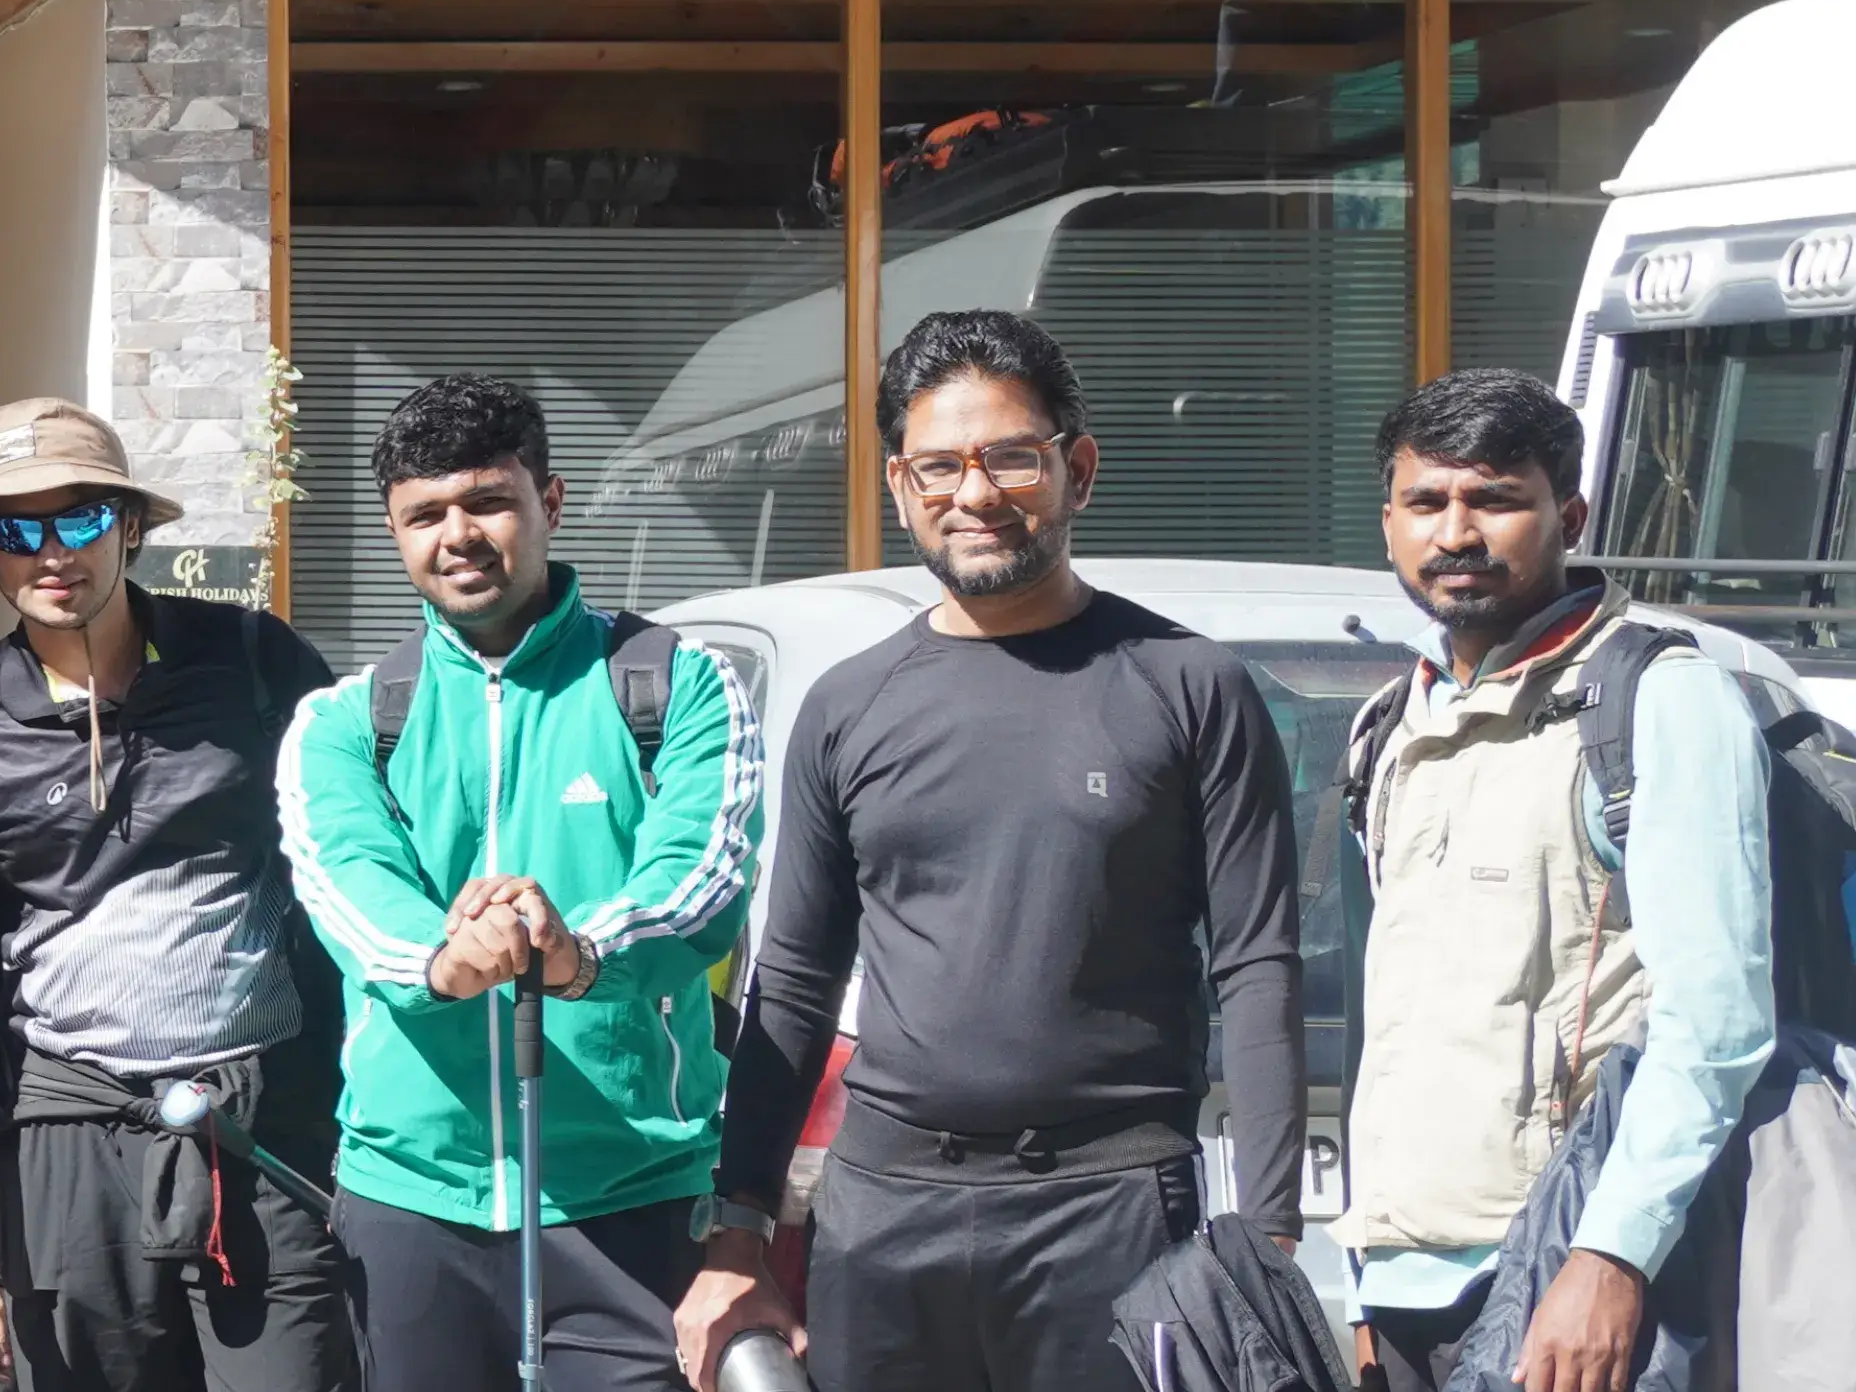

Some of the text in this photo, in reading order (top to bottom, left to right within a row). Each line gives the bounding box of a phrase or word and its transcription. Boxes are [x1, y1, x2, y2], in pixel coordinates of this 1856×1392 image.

[147, 587, 269, 601] RISH HOLIDAYS
[1308, 1135, 1340, 1196] P
